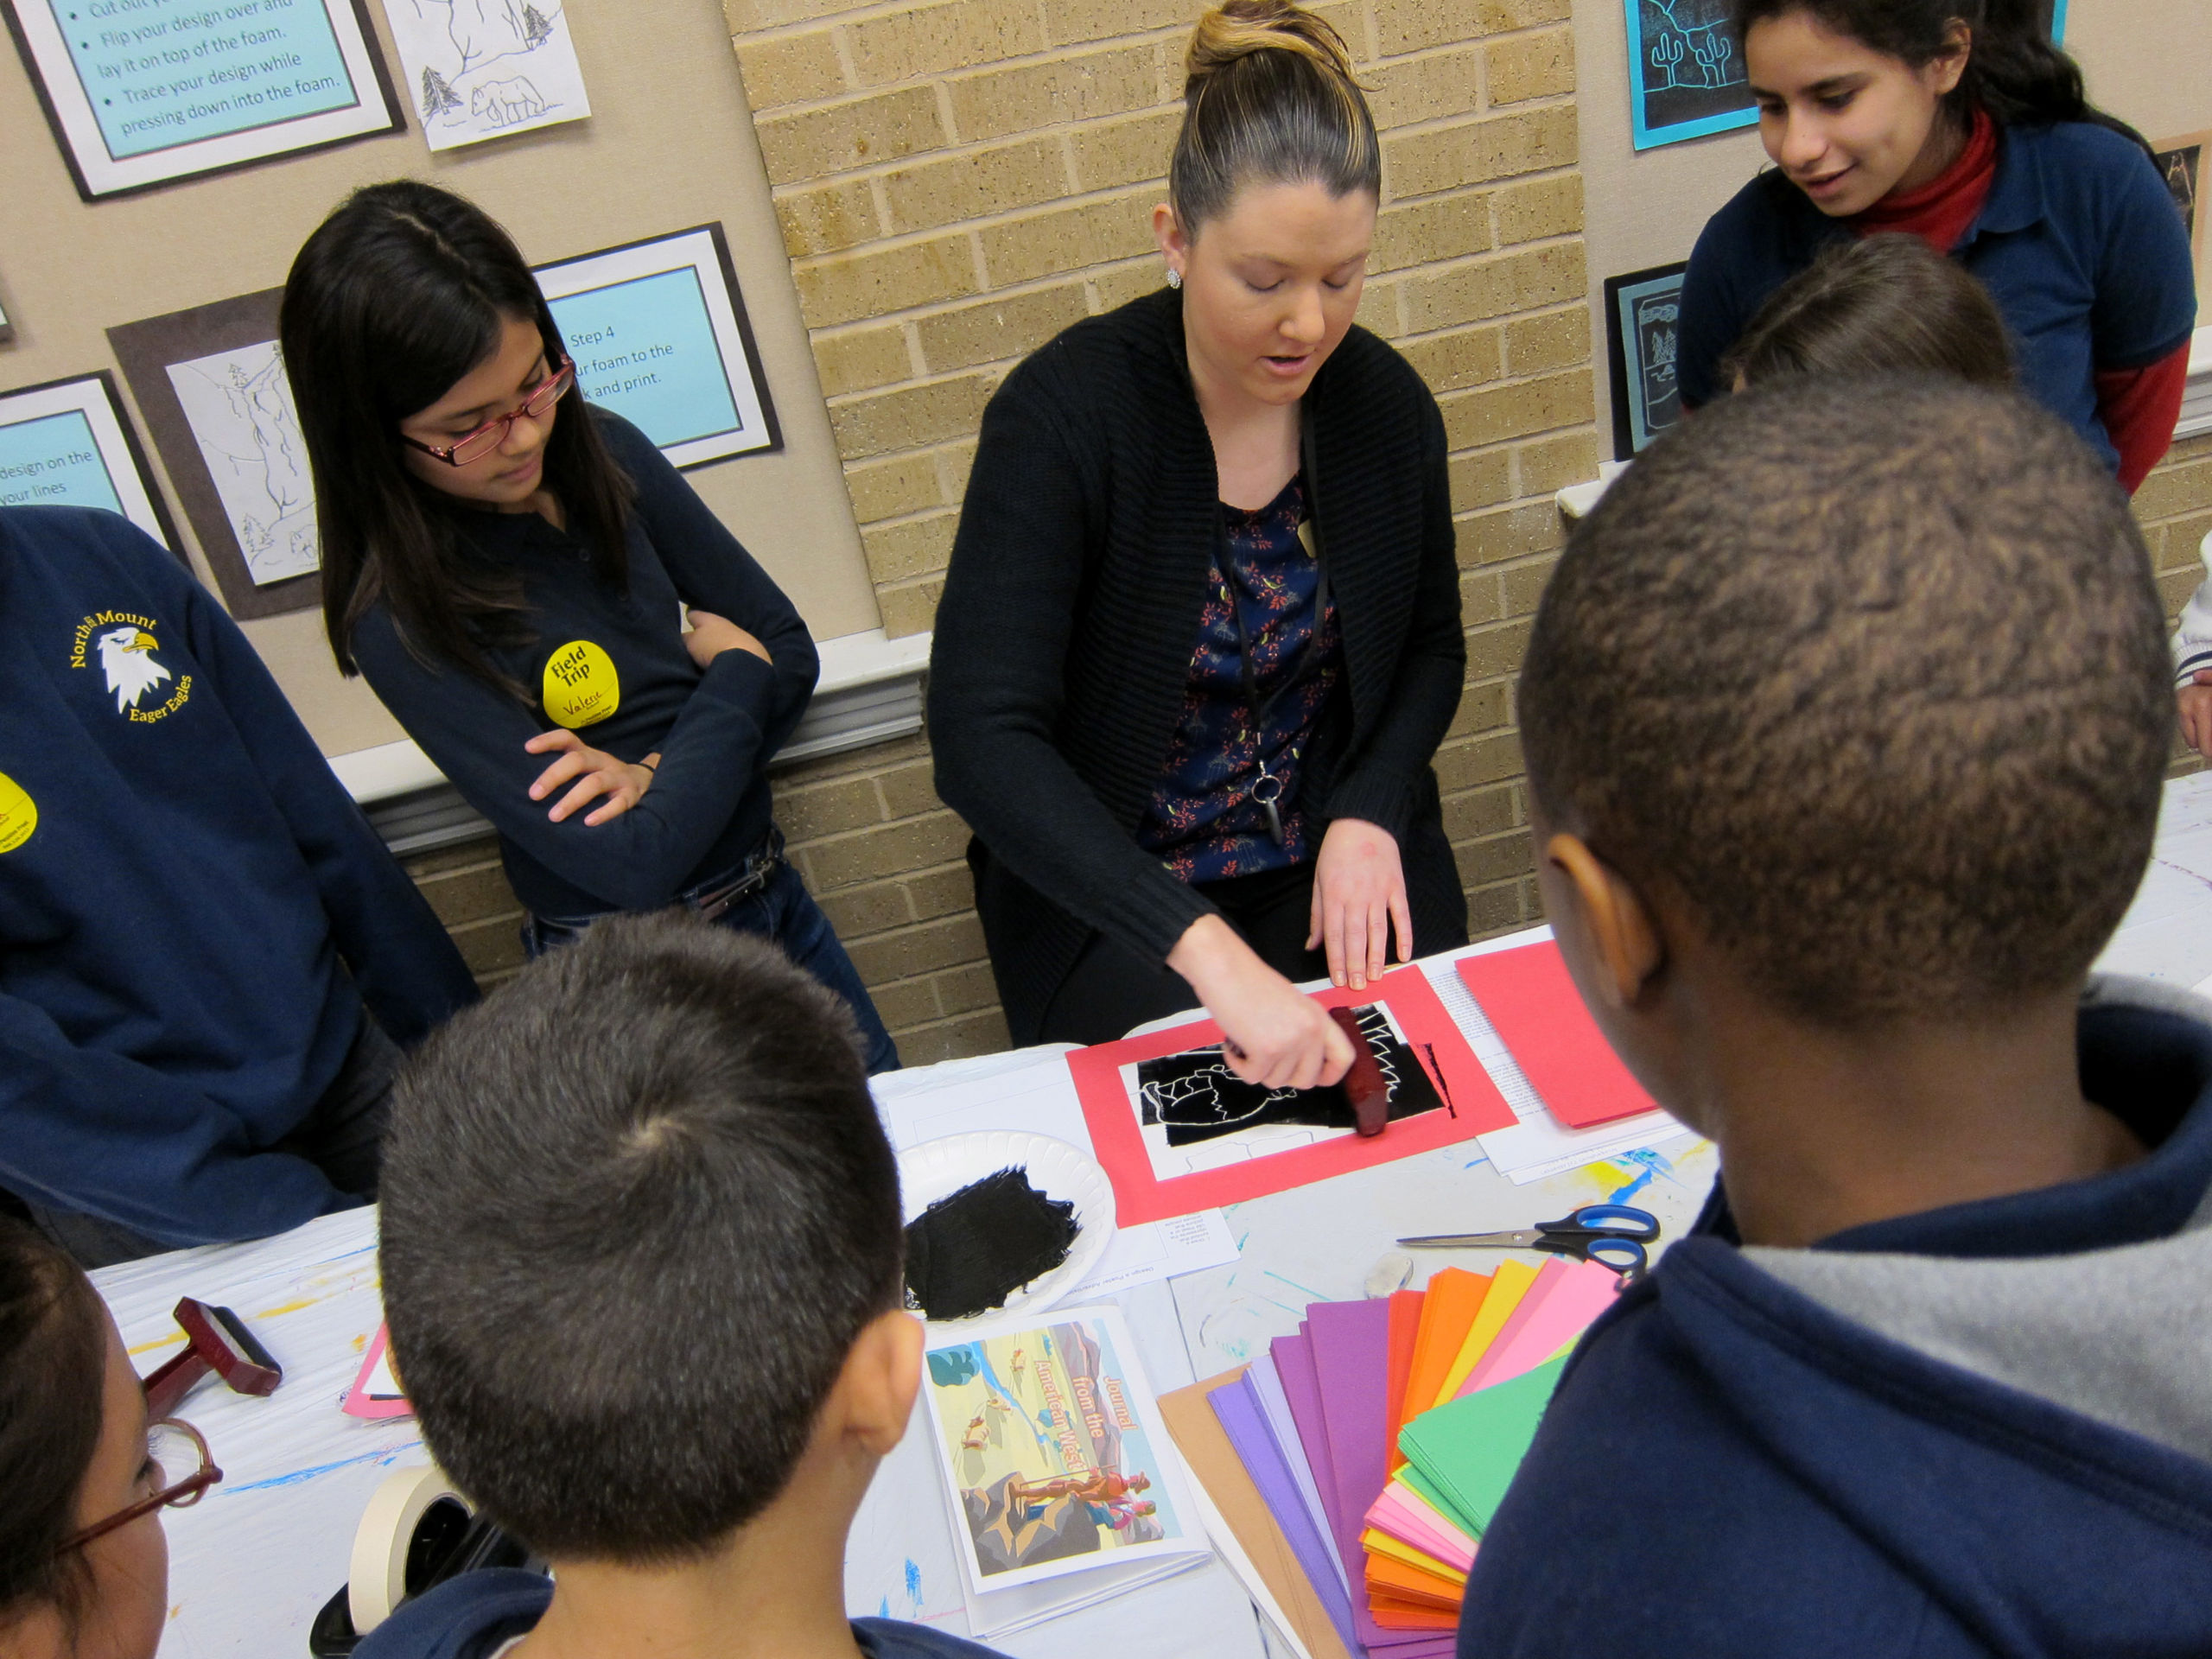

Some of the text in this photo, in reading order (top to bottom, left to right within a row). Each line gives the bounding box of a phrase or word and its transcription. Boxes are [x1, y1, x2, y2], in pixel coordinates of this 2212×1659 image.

[89, 1, 118, 18] Cut
[100, 31, 130, 48] Flip
[131, 22, 168, 44] your
[173, 10, 223, 31] design
[226, 4, 259, 20] over
[97, 28, 287, 79] lay it on top of the foam.
[122, 52, 302, 105] Trace your design while
[121, 76, 341, 137] pressing down into the foam.
[570, 326, 615, 347] Step 4
[593, 355, 629, 372] foam
[632, 350, 647, 364] to
[649, 344, 674, 359] the
[594, 380, 621, 397] and
[623, 372, 662, 393] print.
[0, 450, 92, 480] design on the
[32, 483, 67, 499] lines
[69, 610, 157, 669] North Mount
[551, 645, 587, 678] Field
[562, 664, 590, 687] Trip
[130, 675, 193, 724] Eager Eagles
[1034, 1360, 1086, 1470] American West
[1072, 1376, 1105, 1439] from the
[1103, 1376, 1138, 1431] Journal
